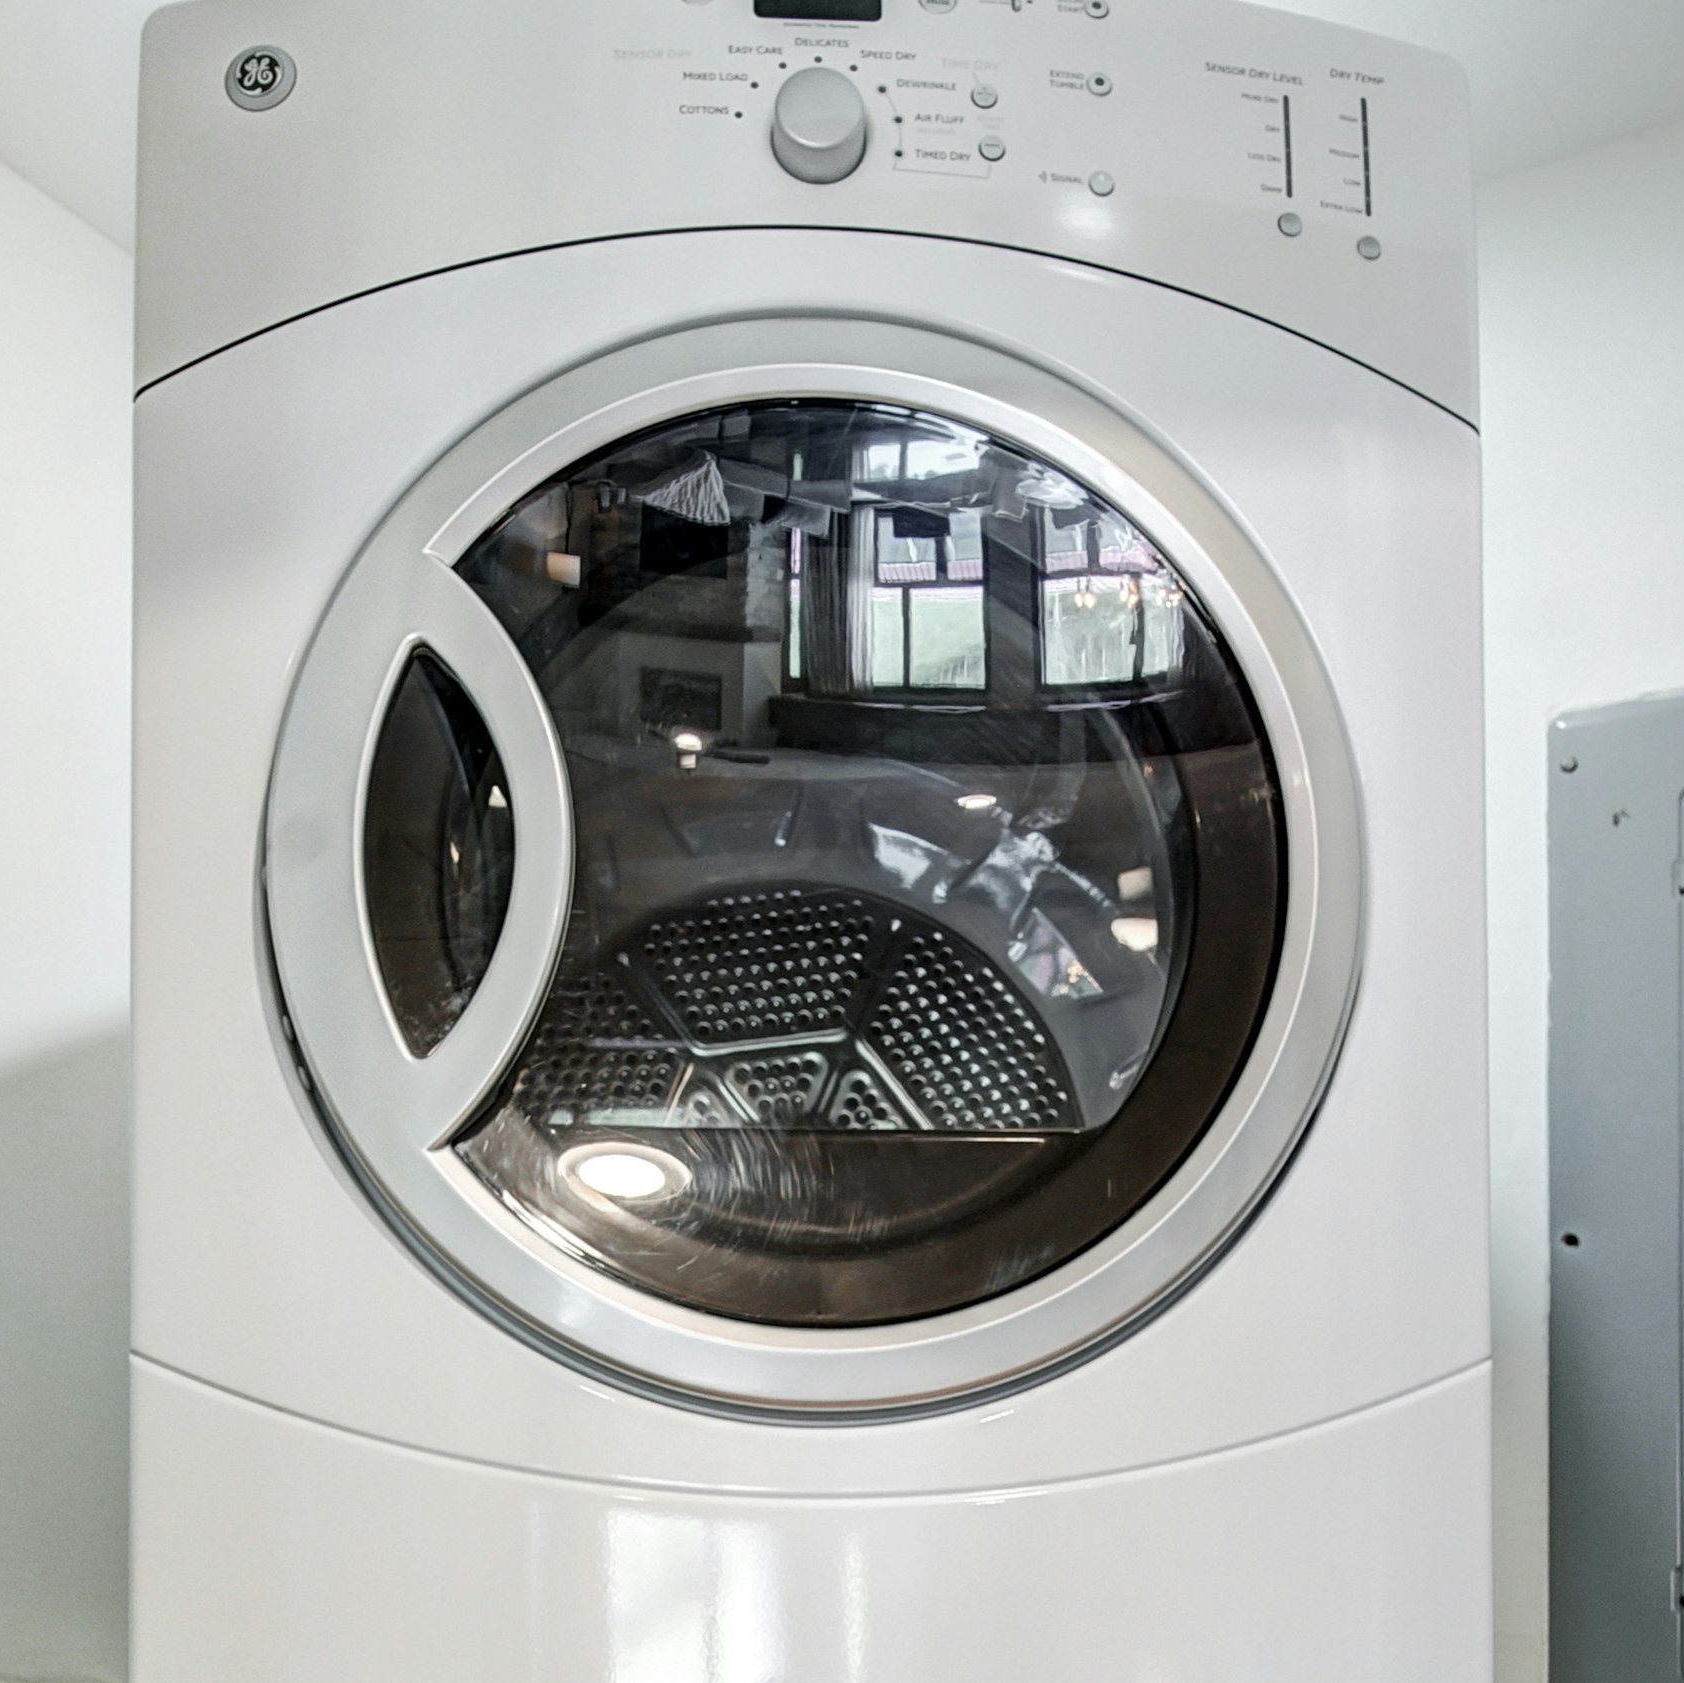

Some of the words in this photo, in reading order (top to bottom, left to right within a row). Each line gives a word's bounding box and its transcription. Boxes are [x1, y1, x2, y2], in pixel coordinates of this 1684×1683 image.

[794, 37, 848, 48] DELICATES
[613, 49, 664, 60] SENSOR
[667, 48, 693, 59] DRY
[728, 45, 754, 55] EASY
[756, 45, 783, 55] CARE
[860, 49, 892, 60] SPEED
[895, 51, 917, 62] DRY
[682, 72, 717, 81] MIXED
[719, 72, 749, 82] LOAD
[1049, 70, 1084, 80] EXTEND
[1205, 62, 1246, 76] SENSOR
[1249, 69, 1271, 79] DRY
[1272, 72, 1303, 86] LEVEL
[1330, 68, 1352, 79] DRY
[1354, 72, 1385, 85] TEMP
[896, 78, 956, 91] DEWRINKLE
[1050, 79, 1084, 90] TUMBLE
[679, 105, 729, 115] COTTONS
[915, 113, 932, 123] AIR
[935, 114, 965, 124] FLUFF
[915, 149, 947, 160] TIMED
[949, 151, 971, 163] DRY
[1051, 173, 1083, 185] SIGNAL
